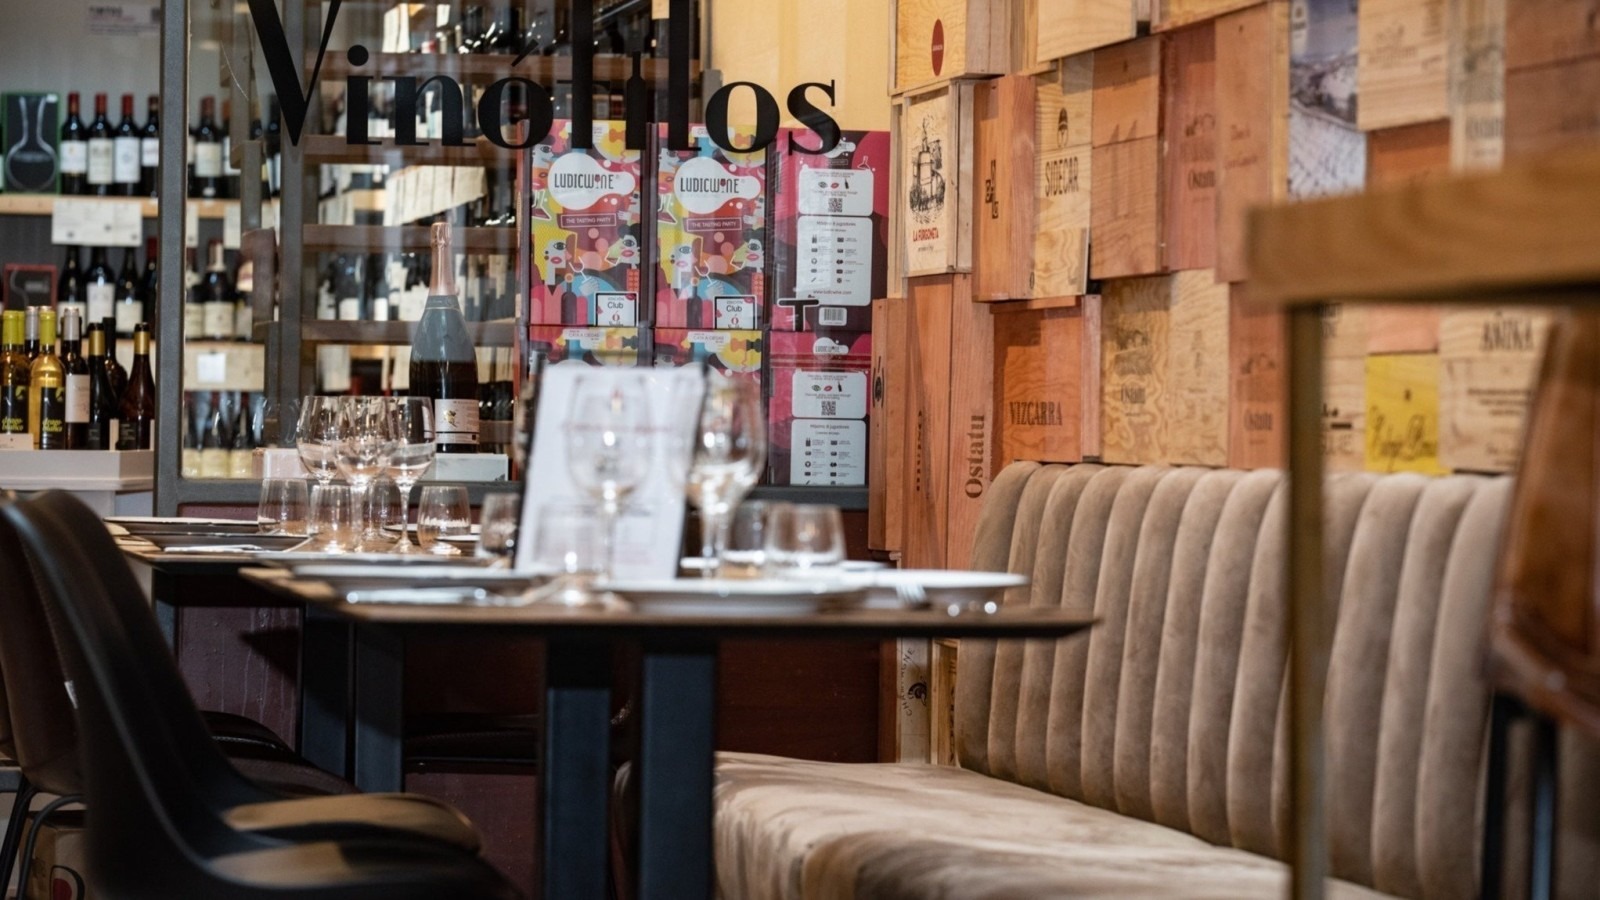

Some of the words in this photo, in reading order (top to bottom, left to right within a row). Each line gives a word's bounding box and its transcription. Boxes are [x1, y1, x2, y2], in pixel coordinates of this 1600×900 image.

[1044, 155, 1080, 198] SIDECAR
[577, 216, 597, 224] TASTING
[597, 215, 612, 223] PARTY
[702, 220, 722, 228] TASTING
[722, 219, 737, 227] PARTY
[607, 301, 624, 309] Club
[726, 305, 742, 313] Club
[1009, 401, 1062, 426] VIZCARRA
[964, 414, 985, 499] Ostatu
